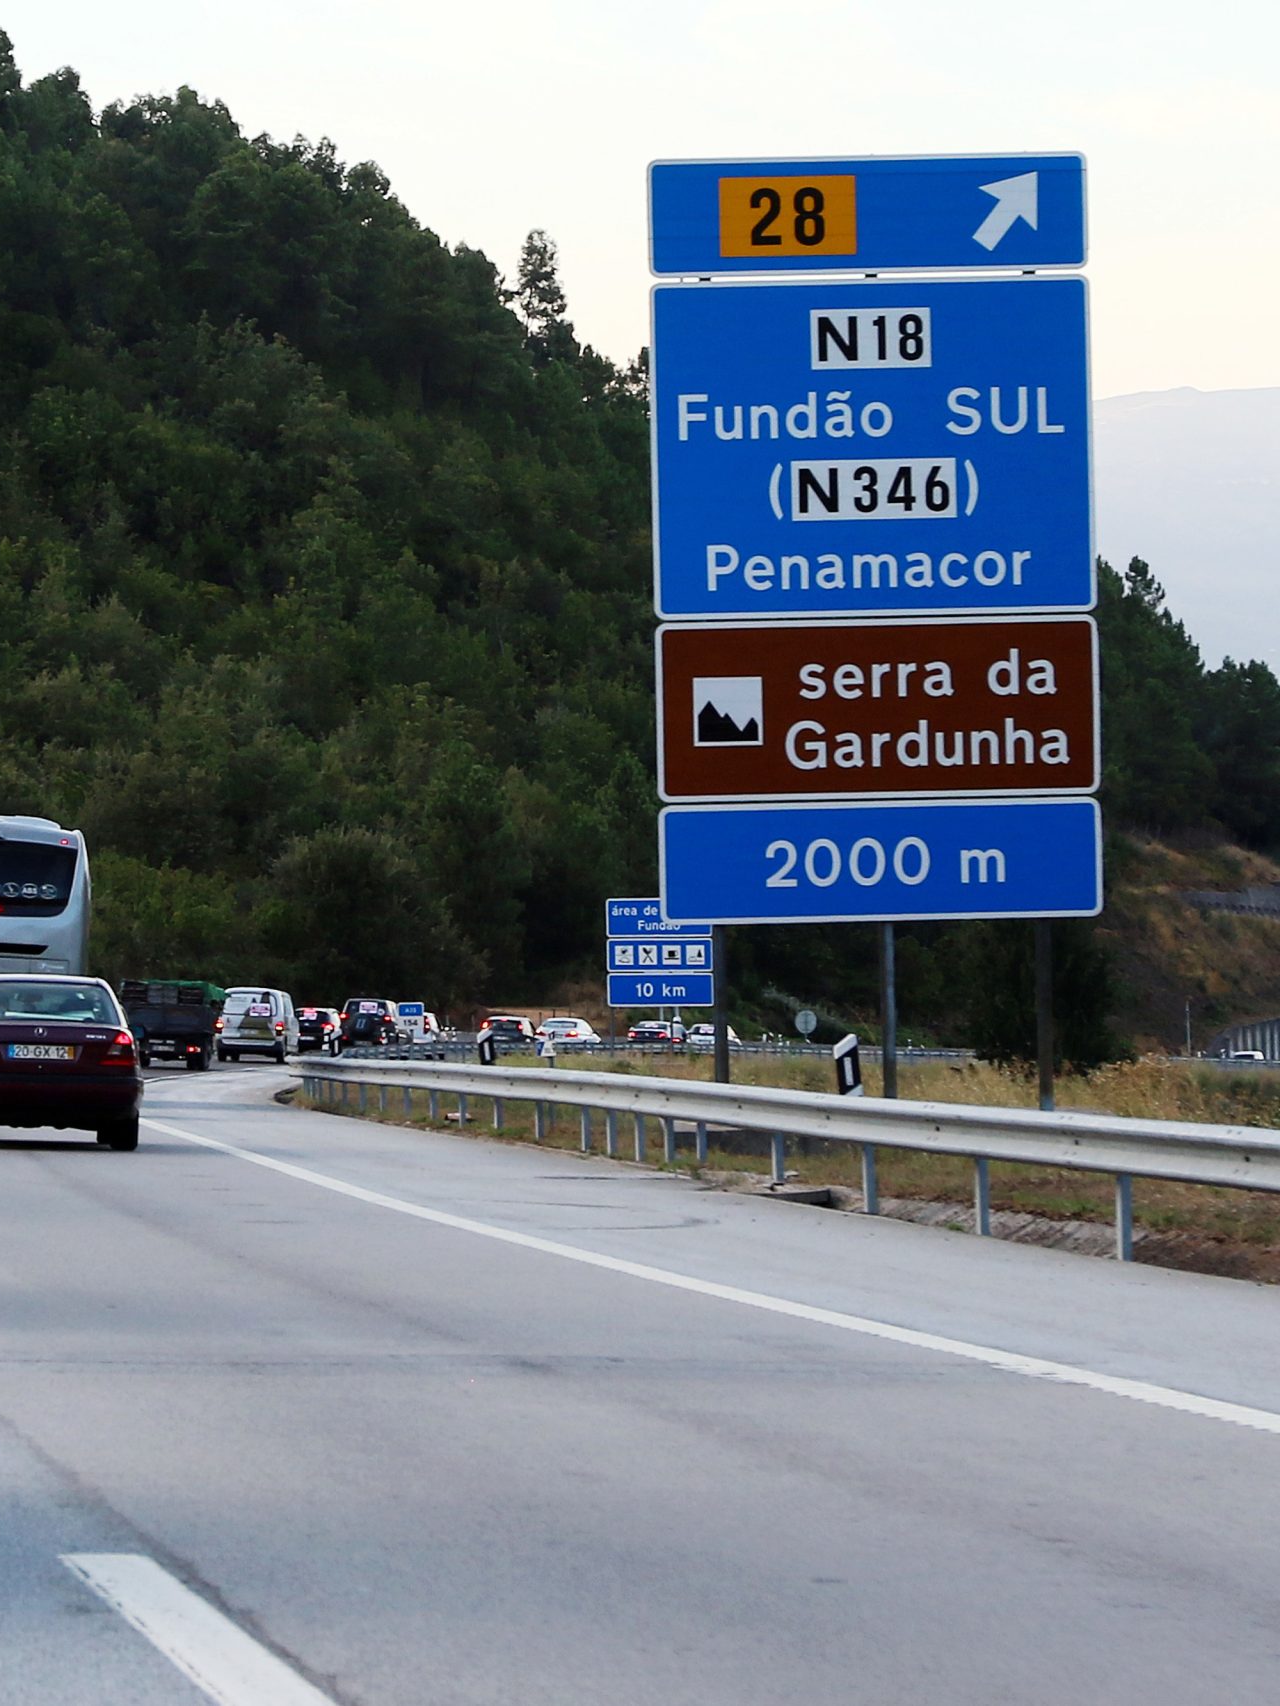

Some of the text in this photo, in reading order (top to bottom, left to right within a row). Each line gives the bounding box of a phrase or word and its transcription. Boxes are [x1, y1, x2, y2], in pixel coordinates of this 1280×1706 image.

[749, 187, 826, 247] 28
[817, 314, 925, 362] N18
[677, 386, 1066, 442] Fundão SUL
[706, 544, 1032, 592] Penamacor
[798, 648, 1058, 700] serra da
[784, 717, 1071, 771] Gardunha
[765, 836, 1006, 888] 2000 m
[611, 905, 658, 916] área de
[635, 983, 686, 998] 10 km
